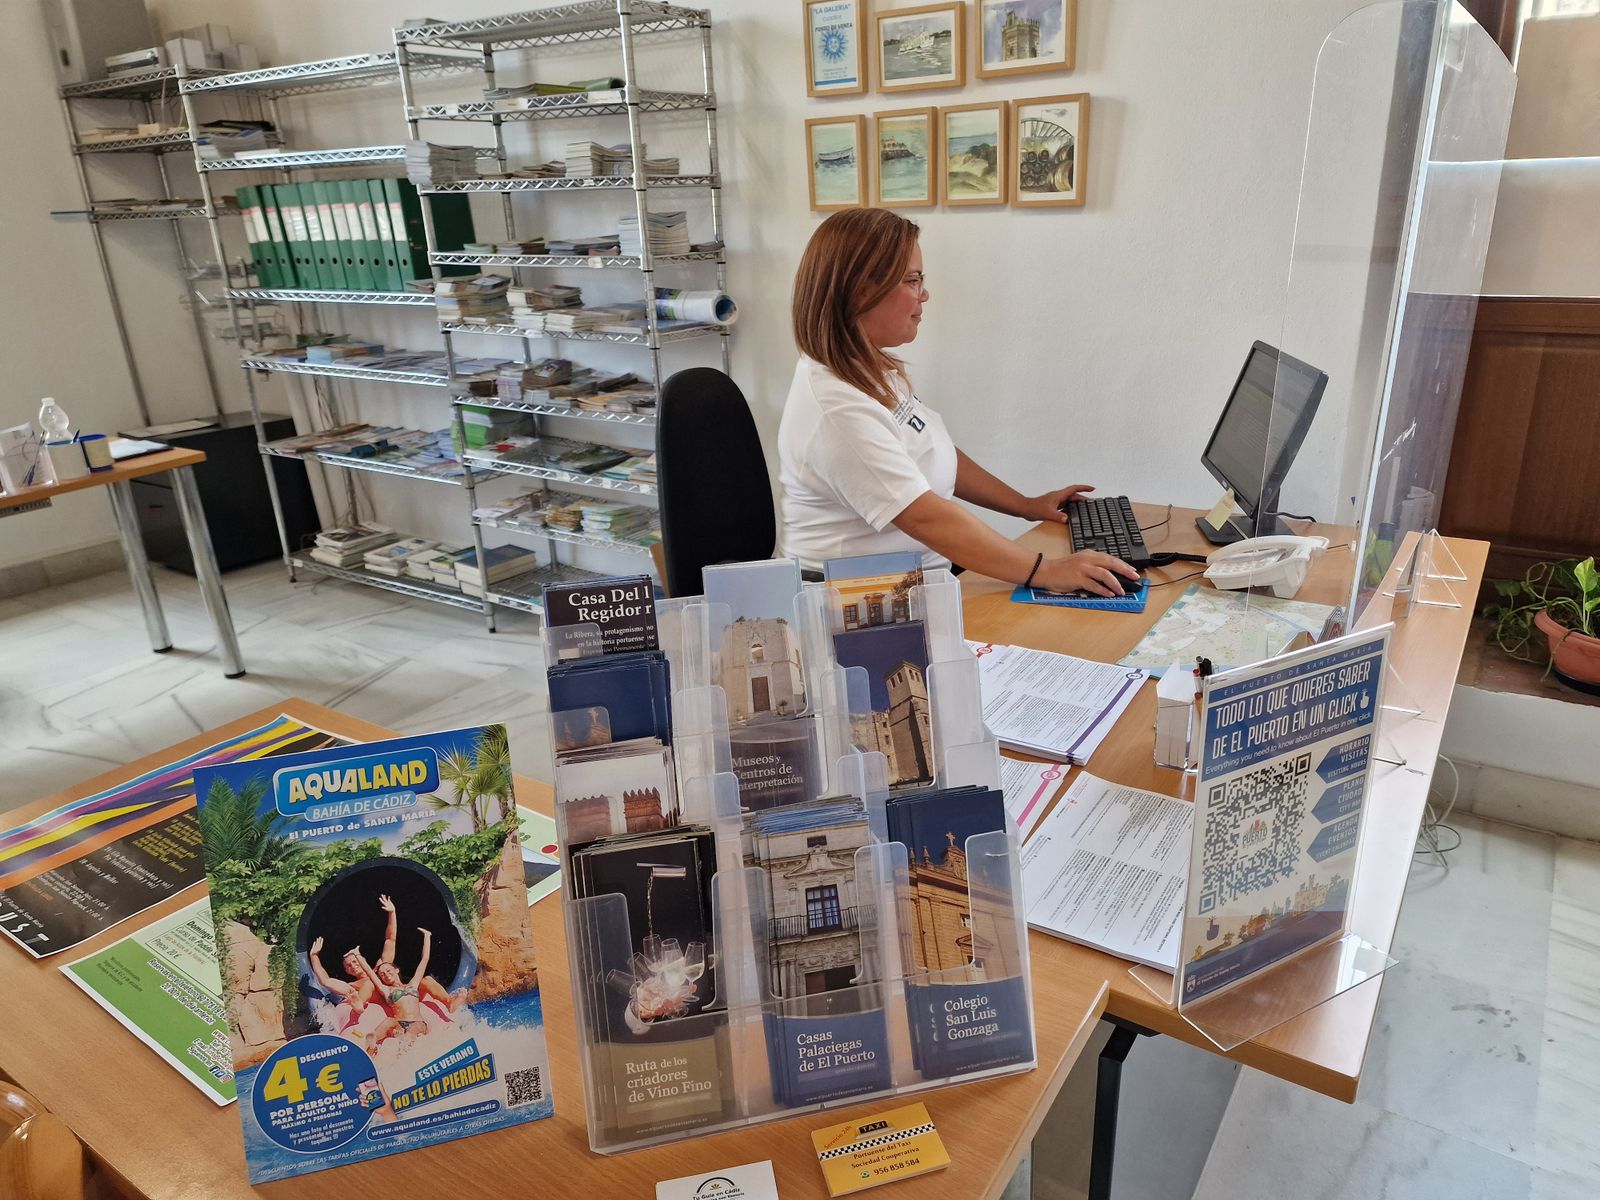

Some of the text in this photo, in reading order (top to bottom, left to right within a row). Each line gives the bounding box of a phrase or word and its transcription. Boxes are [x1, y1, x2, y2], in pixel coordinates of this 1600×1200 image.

[568, 587, 640, 606] Casa Del
[577, 604, 642, 623] Regidor
[604, 625, 644, 637] protagonismo
[616, 635, 645, 646] portuense
[1224, 656, 1337, 696] EL PUERTO DE SANTA
[1216, 661, 1371, 729] TODO LO QUE QUIERES SABER
[1212, 691, 1359, 760] DE EL PUERTO EN UN CLICK
[1205, 755, 1239, 774] Everything
[1241, 751, 1253, 764] you
[1254, 746, 1271, 758] need
[1271, 744, 1278, 752] to
[1278, 738, 1295, 750] know
[1295, 733, 1313, 745] about
[1321, 722, 1340, 735] Puerto
[1340, 721, 1347, 729] in
[1347, 717, 1358, 726] one
[1359, 712, 1371, 723] click
[1339, 736, 1370, 755] HORARIO
[732, 755, 781, 768] Museos y
[1340, 746, 1368, 763] VISITAS
[779, 764, 792, 775] de
[289, 759, 428, 803] AQUALAND
[739, 774, 803, 792] nterpretación
[1343, 776, 1365, 791] PLANO
[312, 793, 411, 820] BAHÍA DE CÁDIZ
[288, 831, 299, 840] El
[302, 824, 344, 839] PUERTO
[347, 822, 360, 831] de
[364, 815, 398, 828] SANTA
[1242, 828, 1268, 845] PUERTO
[1328, 826, 1356, 845] EVENTOS
[944, 995, 988, 1012] Colegio
[946, 1007, 997, 1026] San Luis
[797, 1031, 833, 1045] Casas
[948, 1023, 999, 1040] Gonzaga
[300, 1045, 349, 1064] DESCUENTO
[798, 1039, 863, 1059] Palaciegas
[417, 1045, 475, 1080] ESTE VERANO
[625, 1057, 687, 1074] Ruta de los
[799, 1060, 815, 1072] de
[818, 1056, 831, 1069] El
[834, 1050, 875, 1066] Puerto
[263, 1056, 308, 1104] 4
[315, 1063, 344, 1093] €
[393, 1058, 492, 1110] NO TE LO PIERDAS
[627, 1070, 688, 1089] criadores
[628, 1090, 645, 1103] de
[647, 1085, 679, 1099] Vino
[682, 1080, 712, 1094] Fino
[269, 1092, 350, 1119] POR PERSONA
[271, 1115, 294, 1127] PARA
[296, 1107, 327, 1120] ADULTO
[313, 1110, 343, 1122] PERSONAS
[371, 1102, 497, 1137] www.aqualand.es/bahiadecadiz
[862, 1121, 887, 1132] TAXI
[823, 1132, 842, 1149] Servicio
[853, 1140, 912, 1159] Portuense del Taxi
[851, 1157, 881, 1169] Sociedad
[873, 1158, 920, 1176] 956 858 584
